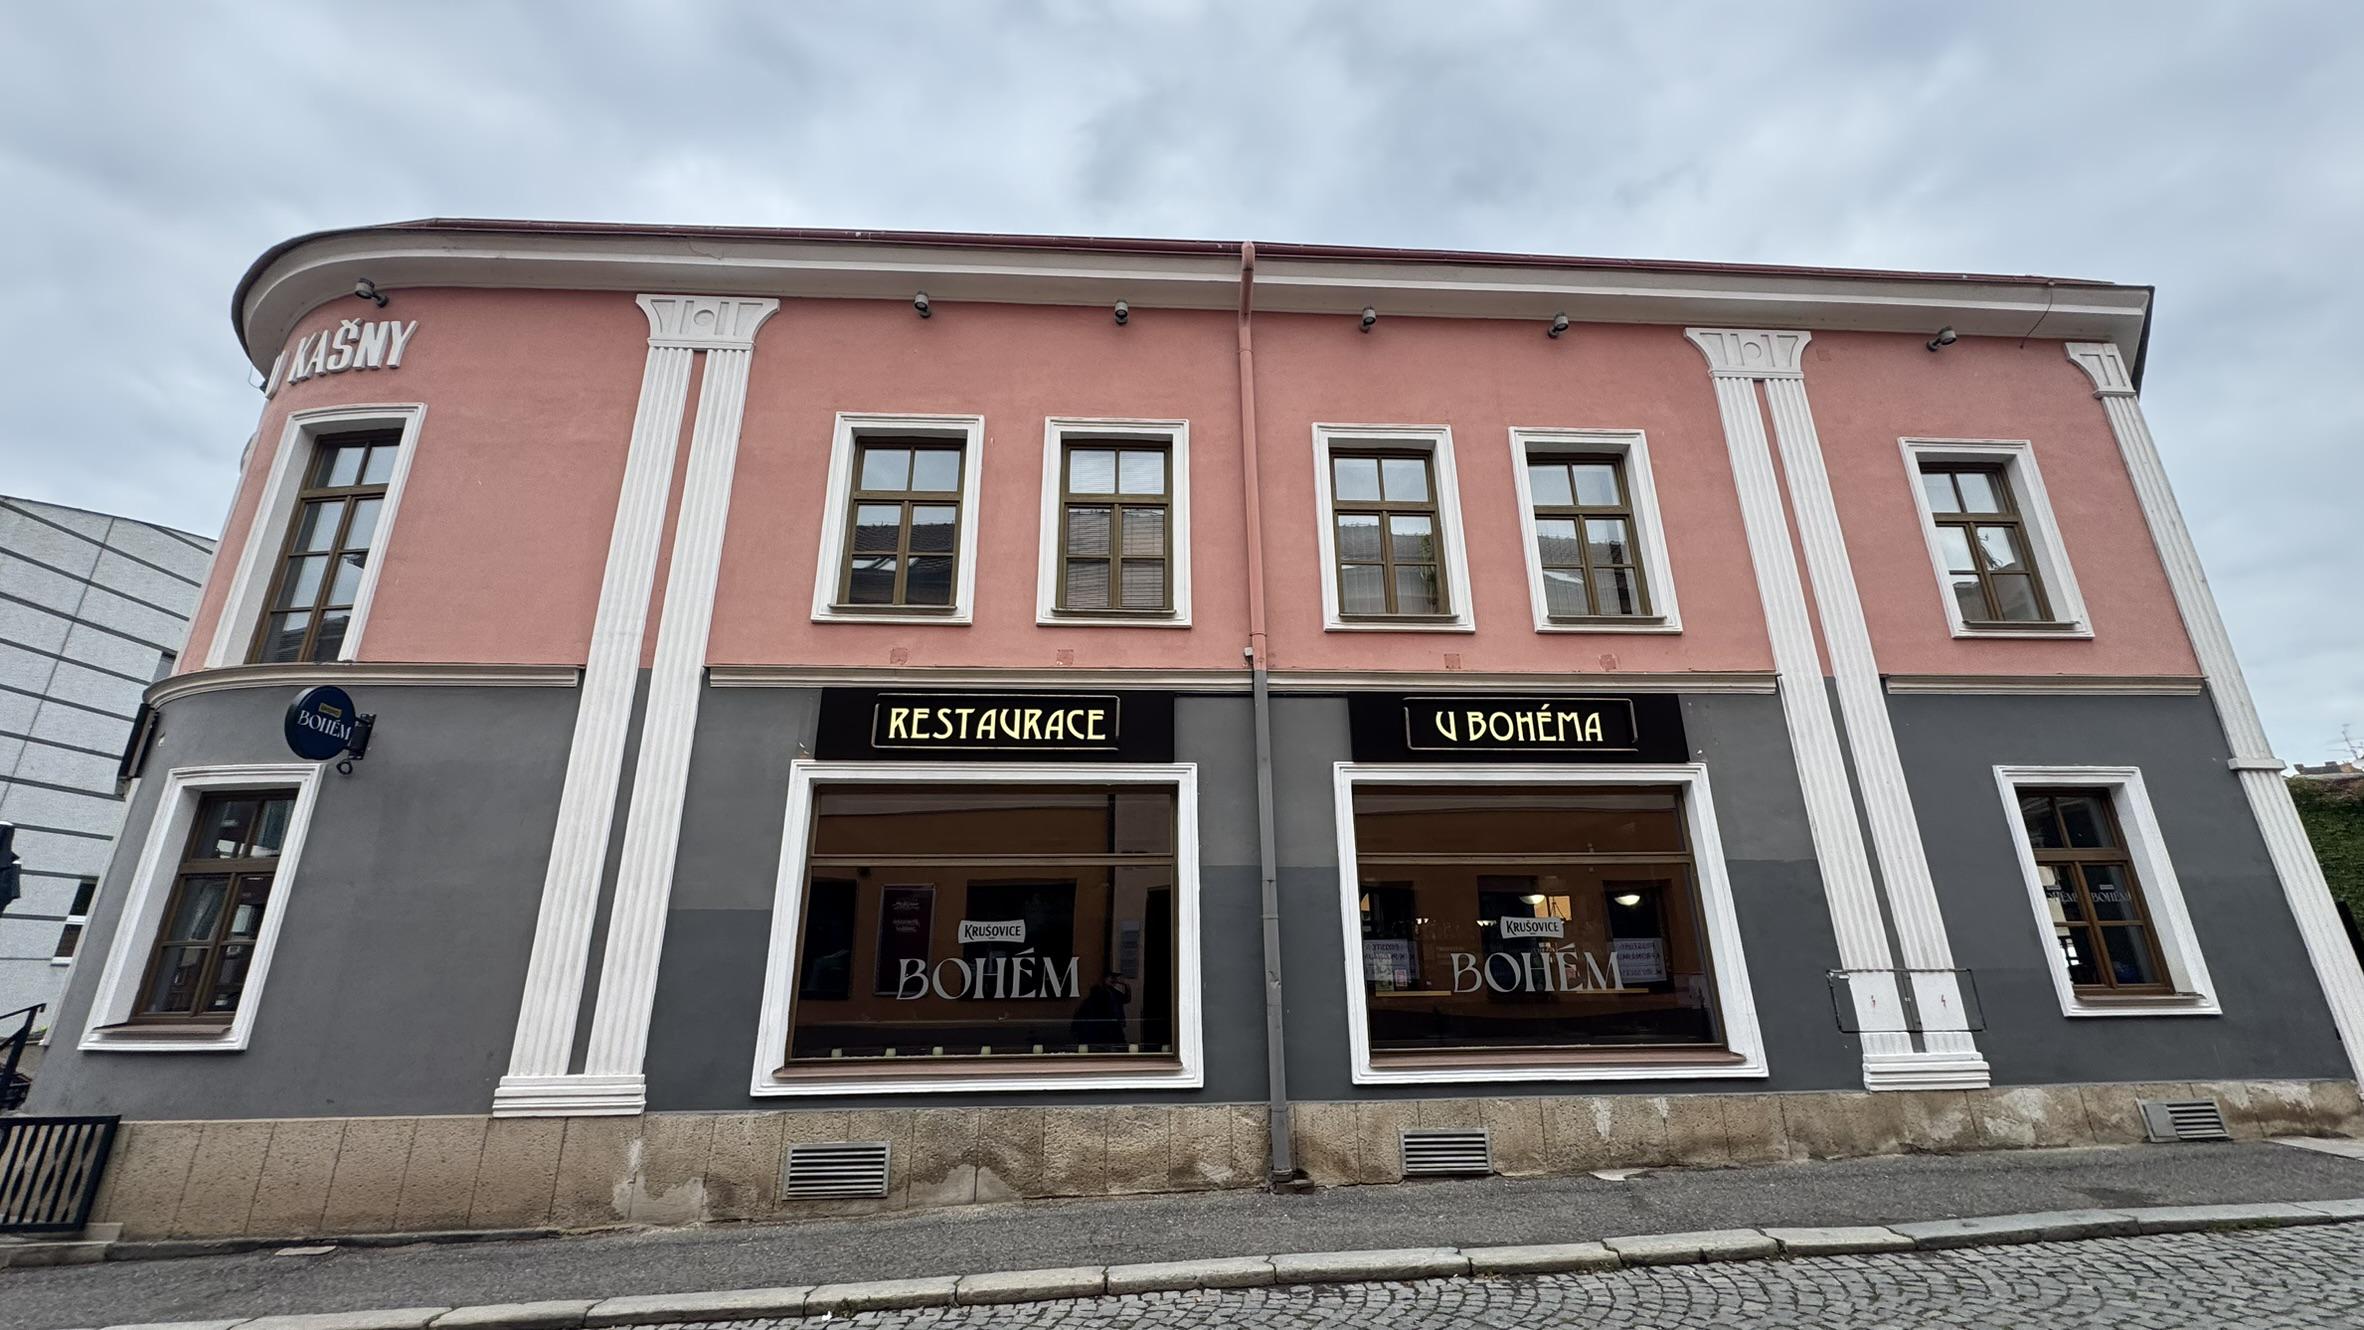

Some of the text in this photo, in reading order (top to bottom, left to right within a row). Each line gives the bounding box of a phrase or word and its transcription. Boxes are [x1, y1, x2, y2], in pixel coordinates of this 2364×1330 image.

[287, 317, 419, 385] KAŠNY
[297, 709, 352, 741] BOHÉM
[888, 707, 1106, 740] RESTAURACE
[1435, 703, 1604, 742] U BOHÉMA
[964, 924, 1022, 941] KRUŠOVICE
[1506, 920, 1560, 936] KRUŠOVICE
[896, 947, 1081, 1000] BOHÉM
[1450, 943, 1625, 993] BOHÉM
